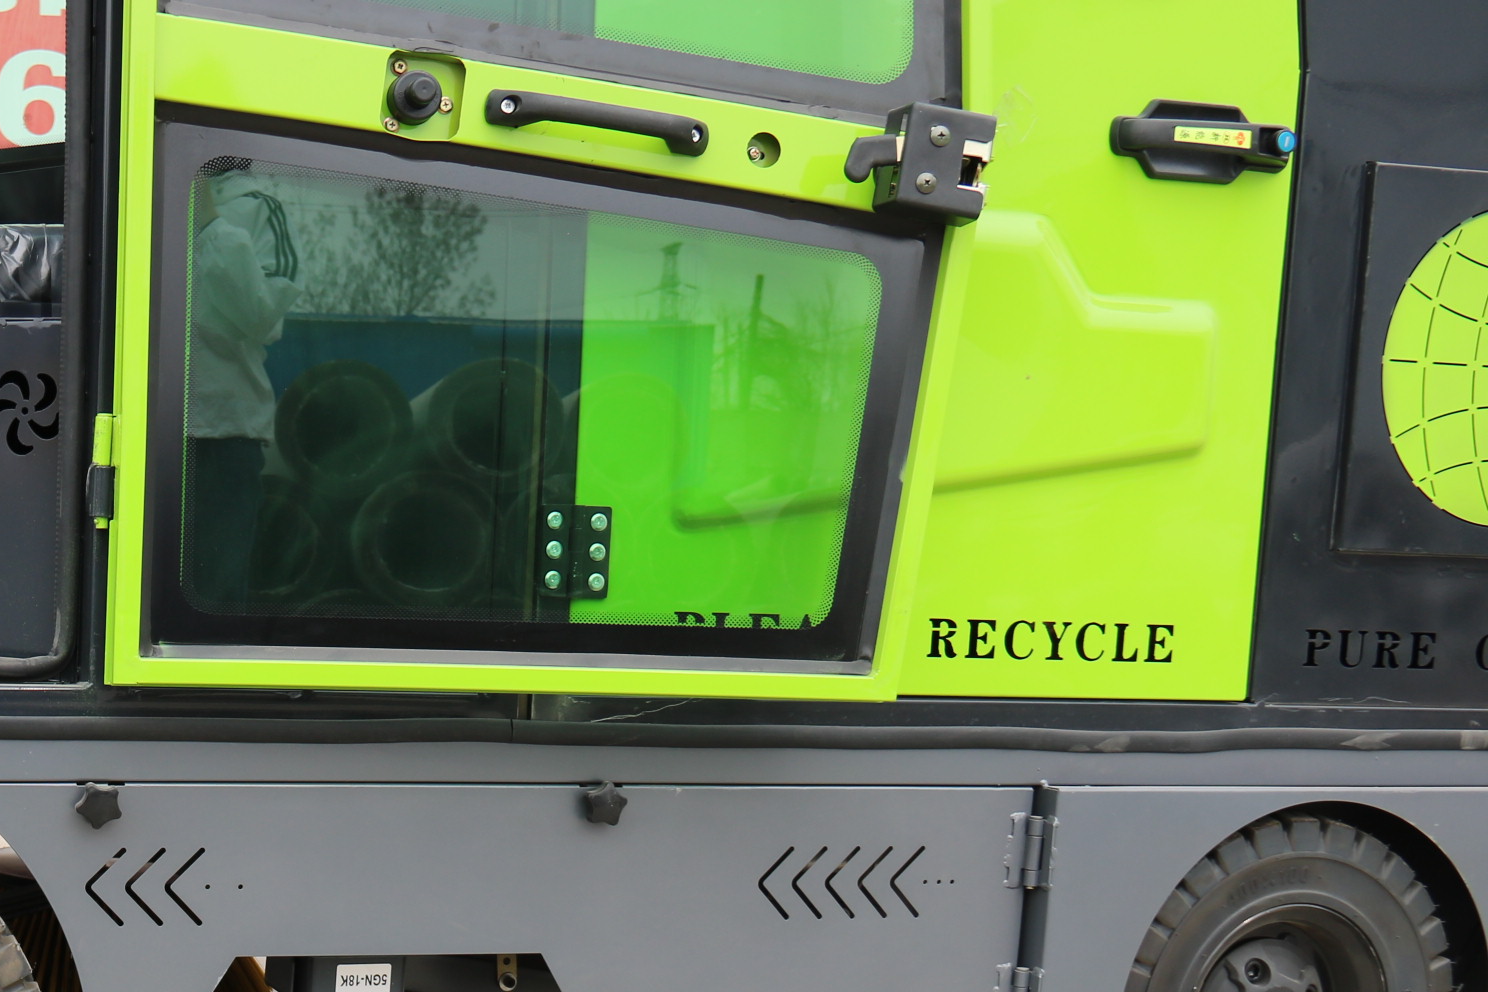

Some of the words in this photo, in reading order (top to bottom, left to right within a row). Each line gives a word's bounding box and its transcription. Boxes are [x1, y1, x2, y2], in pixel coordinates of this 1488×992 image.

[926, 618, 1175, 663] RECYCLE
[1302, 629, 1437, 669] PURE
[340, 973, 387, 987] 5GN-18K
